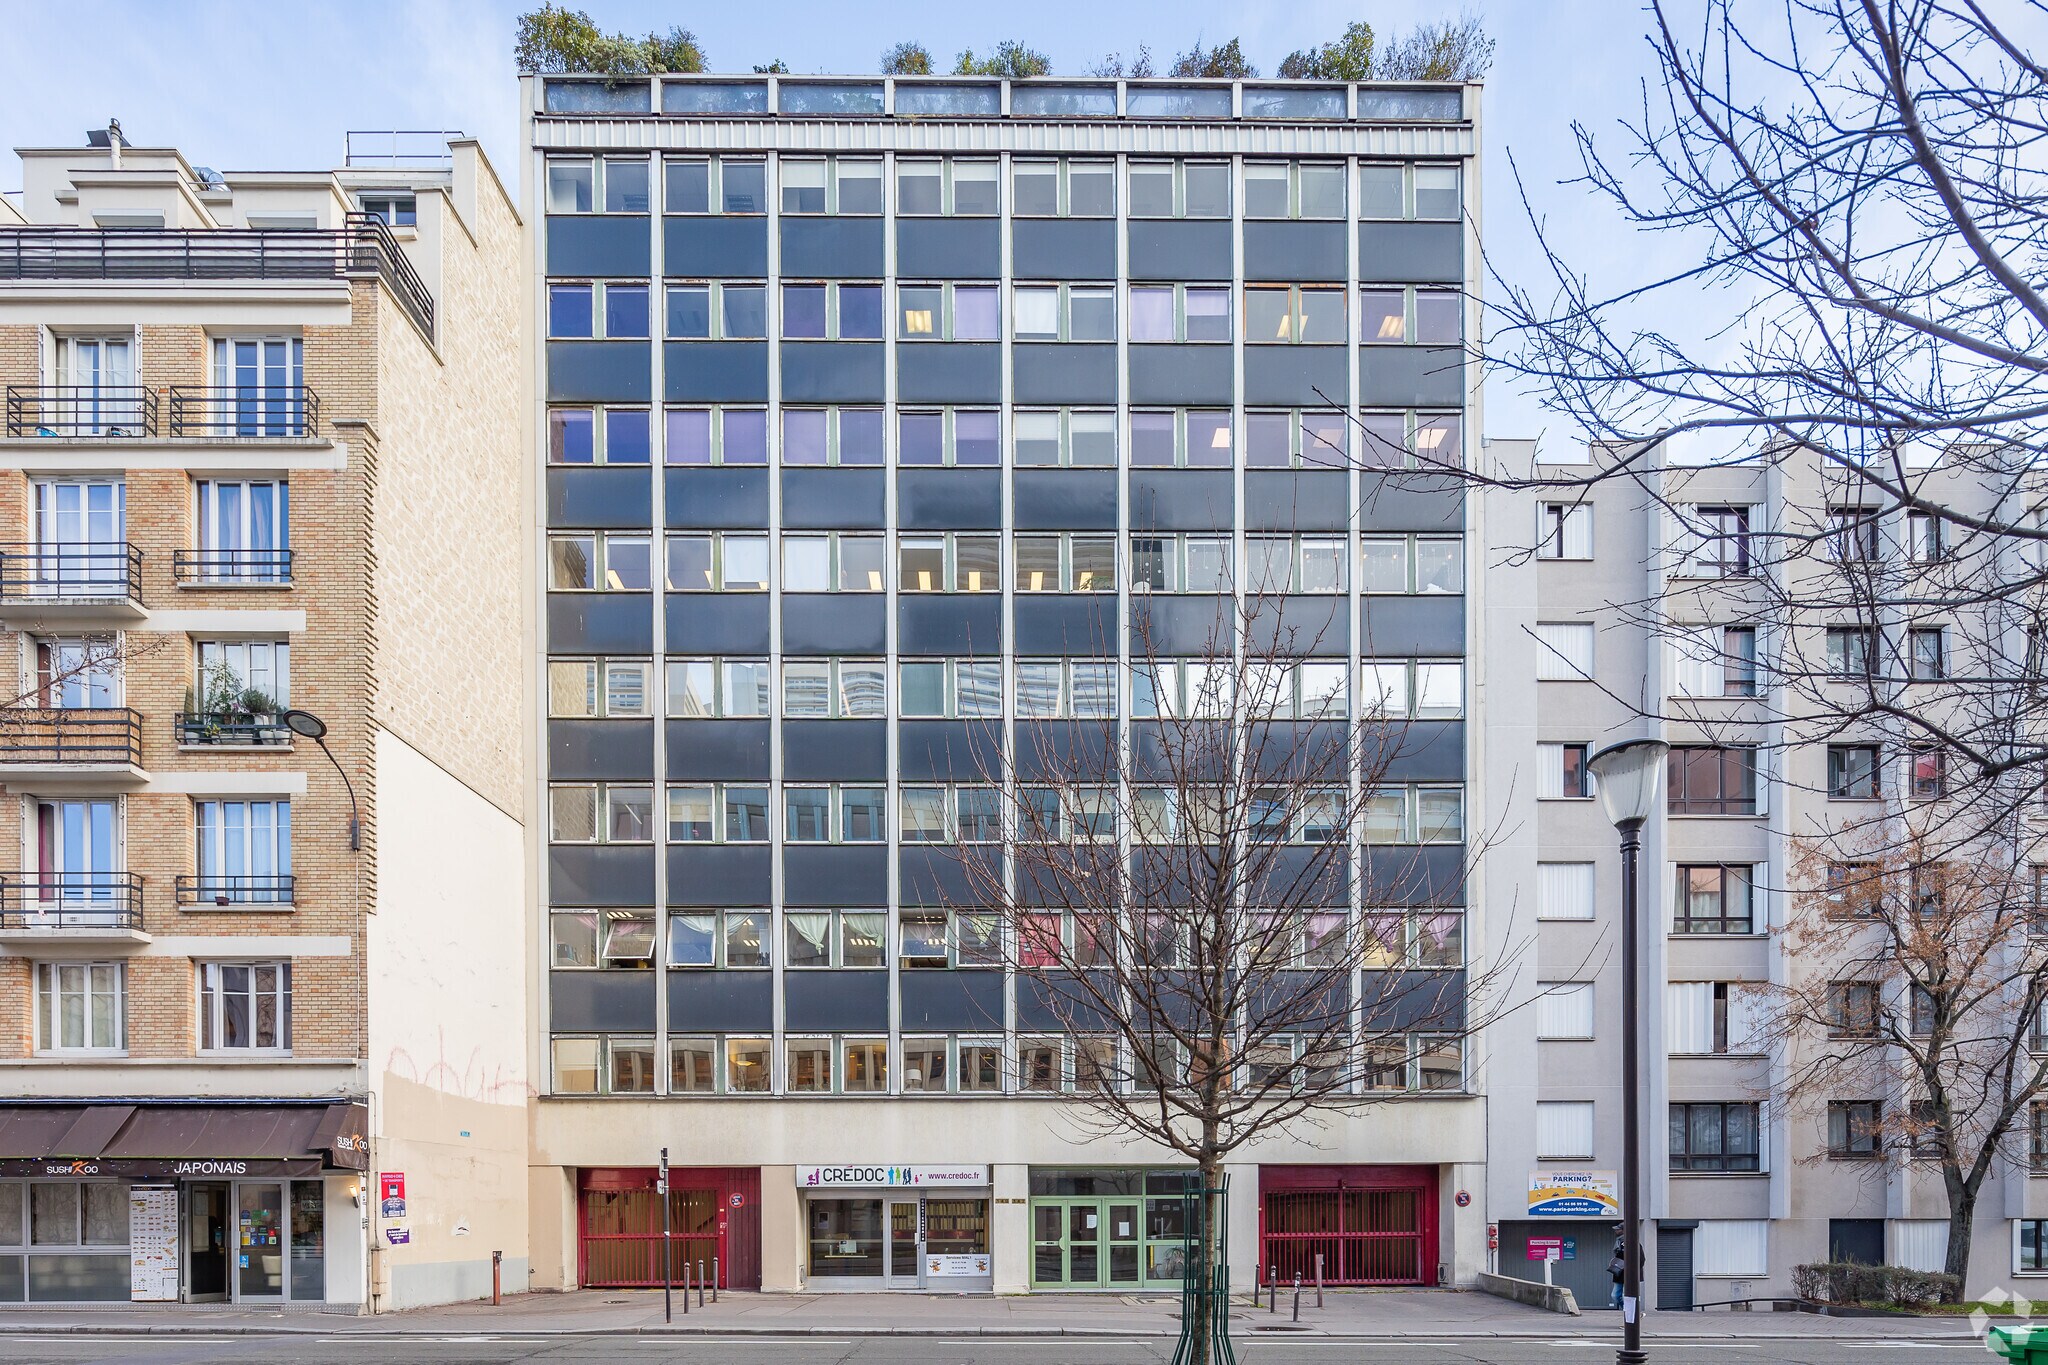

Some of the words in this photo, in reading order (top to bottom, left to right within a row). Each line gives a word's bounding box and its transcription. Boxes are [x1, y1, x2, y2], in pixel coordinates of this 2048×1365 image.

[174, 1162, 246, 1174] JAPONAIS
[823, 1164, 885, 1182] CRÉDOC
[928, 1172, 980, 1180] www.credoc.fr
